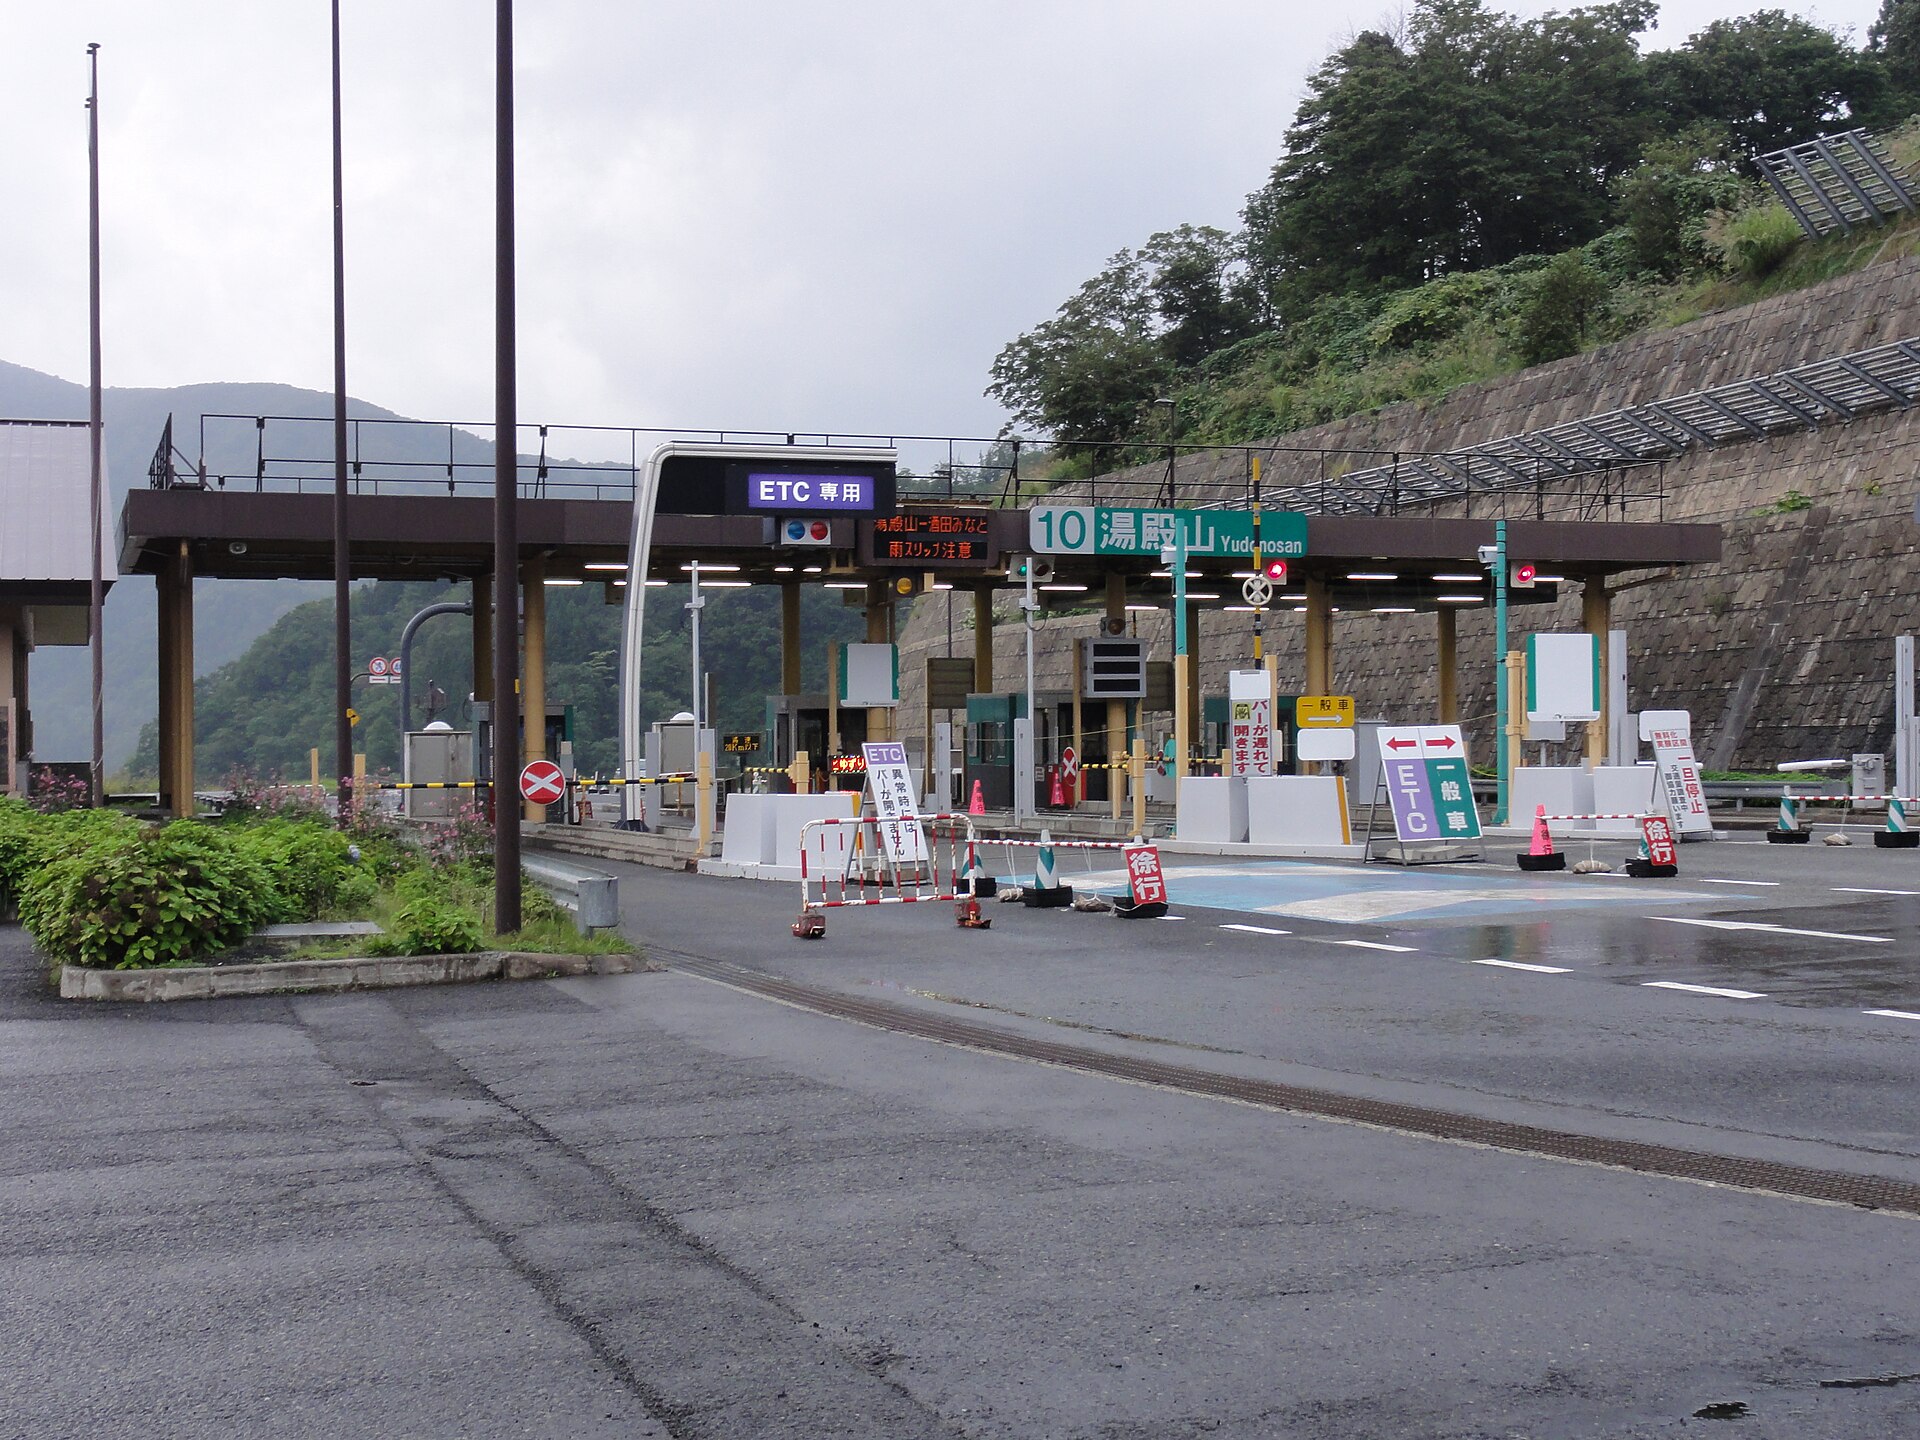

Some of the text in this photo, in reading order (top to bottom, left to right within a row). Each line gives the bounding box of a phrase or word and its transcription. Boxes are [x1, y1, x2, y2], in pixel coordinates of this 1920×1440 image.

[759, 480, 861, 503] ETC 専用
[1038, 510, 1087, 551] 10
[1100, 512, 1215, 552] 湯殿山
[1302, 699, 1349, 711] 一般車
[868, 747, 902, 762] ETC
[1233, 725, 1251, 774] 開きます
[1251, 700, 1269, 773] バーが遅れて
[891, 768, 915, 833] 異常時には
[1397, 765, 1428, 833] ETC
[1436, 765, 1469, 832] 一般車
[1677, 756, 1705, 814] 一旦停止
[1645, 820, 1673, 863] 徐行
[1129, 851, 1162, 901] 徐行
